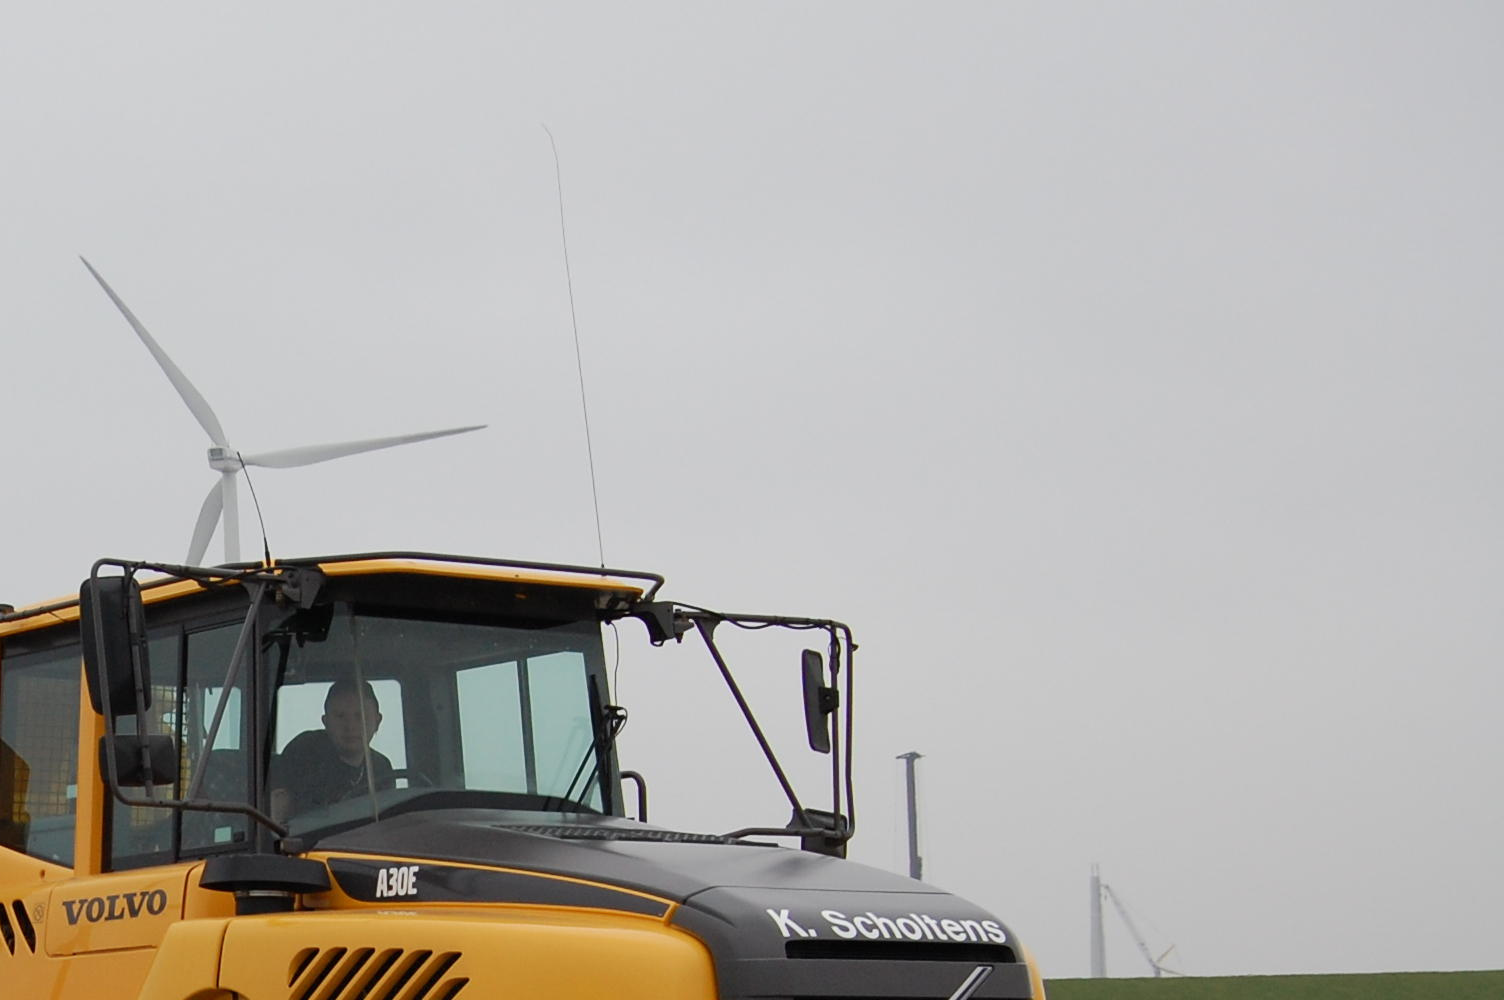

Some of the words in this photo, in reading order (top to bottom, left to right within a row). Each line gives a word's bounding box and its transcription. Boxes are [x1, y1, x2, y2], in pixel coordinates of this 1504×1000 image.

[376, 865, 419, 898] A30E
[62, 889, 167, 925] VOLVO
[766, 908, 818, 938] K.
[821, 910, 1007, 944] Scholtens
